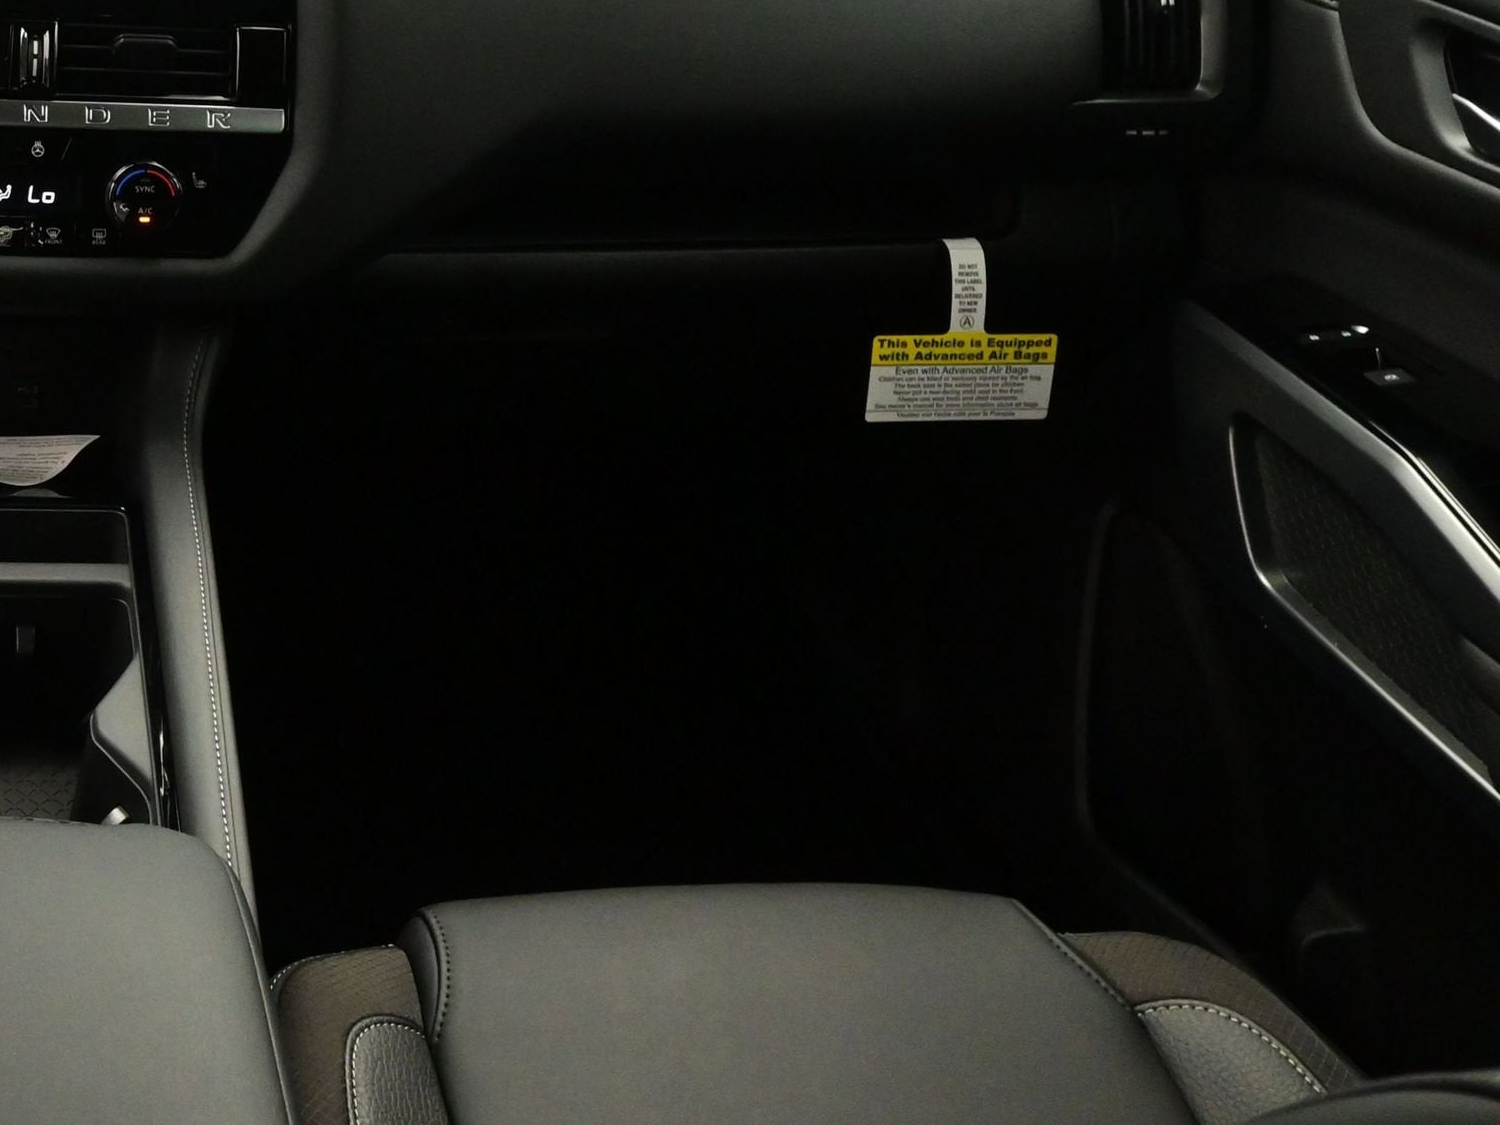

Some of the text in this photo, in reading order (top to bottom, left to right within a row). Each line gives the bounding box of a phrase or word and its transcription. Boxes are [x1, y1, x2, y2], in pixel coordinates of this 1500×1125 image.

[134, 184, 156, 193] SYNC
[26, 185, 56, 206] Lo
[137, 207, 154, 215] A/C
[877, 337, 1053, 350] This Vehicle is Equipped
[878, 350, 1049, 363] with Advanced Air Bags
[895, 366, 1029, 376] Even with Advanced Air Bags
